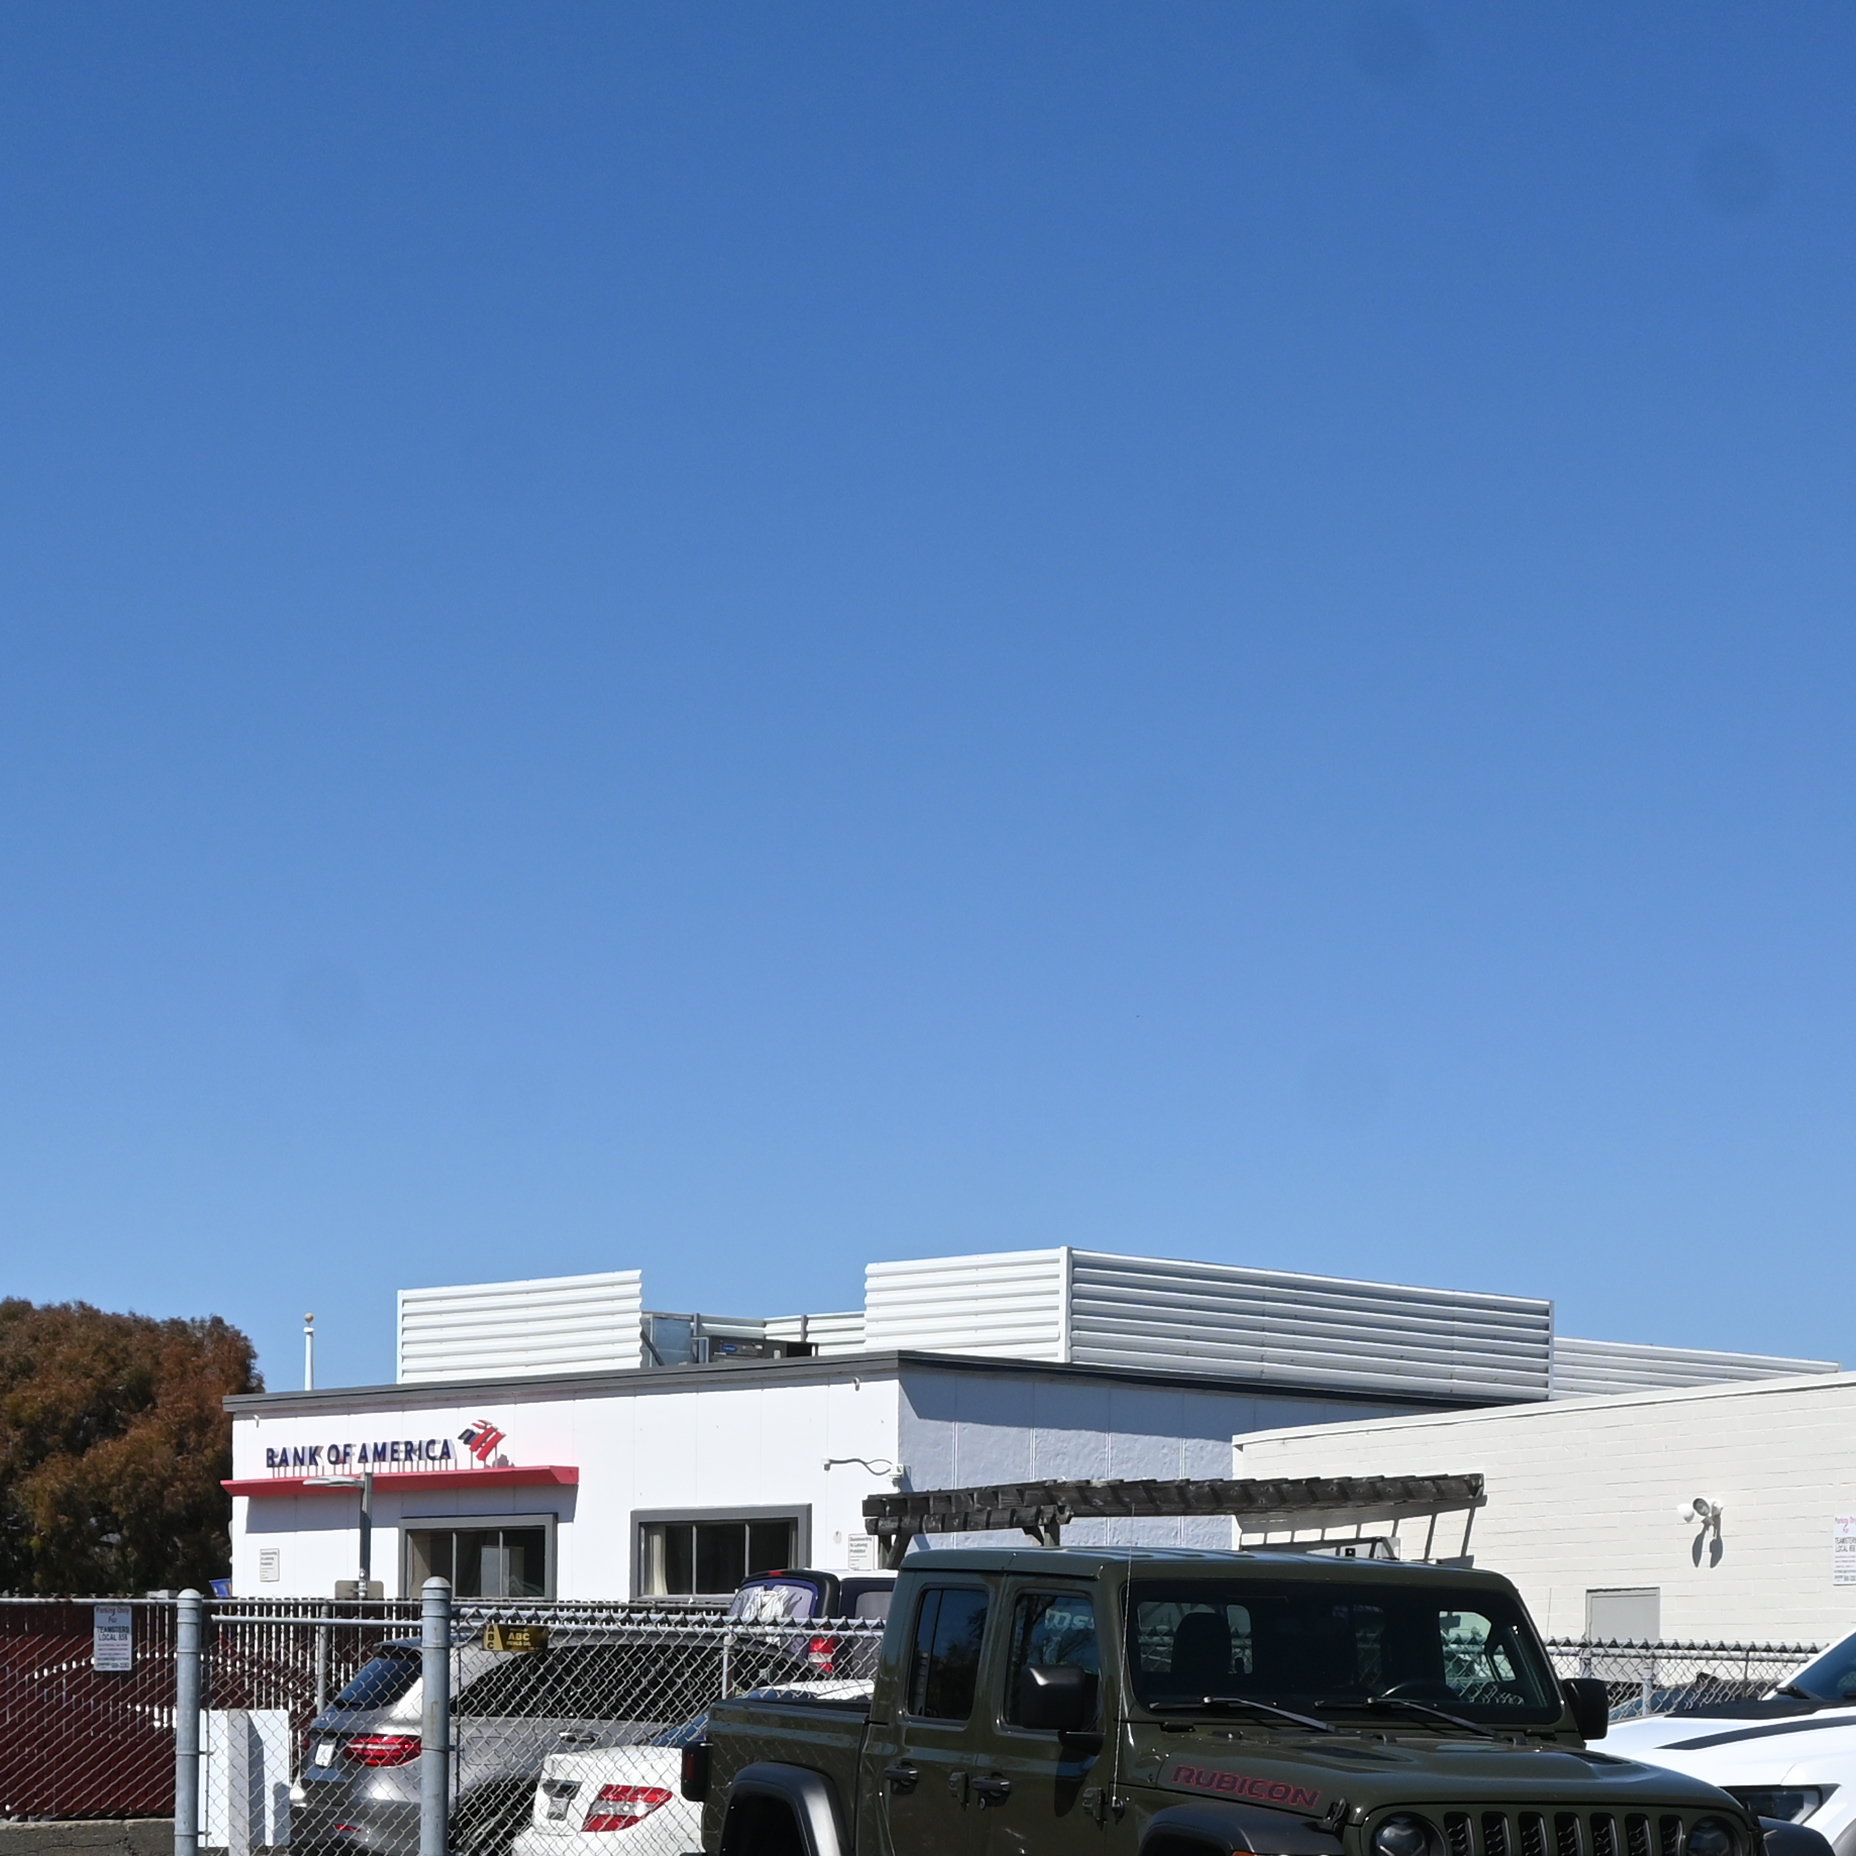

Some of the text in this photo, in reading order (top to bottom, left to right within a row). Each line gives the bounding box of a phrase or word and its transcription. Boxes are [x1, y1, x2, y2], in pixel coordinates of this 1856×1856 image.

[266, 1438, 452, 1468] BANK OF AMERICA
[96, 1606, 115, 1616] Parking
[507, 1631, 531, 1641] ABC
[1172, 1765, 1320, 1808] RUBICON
